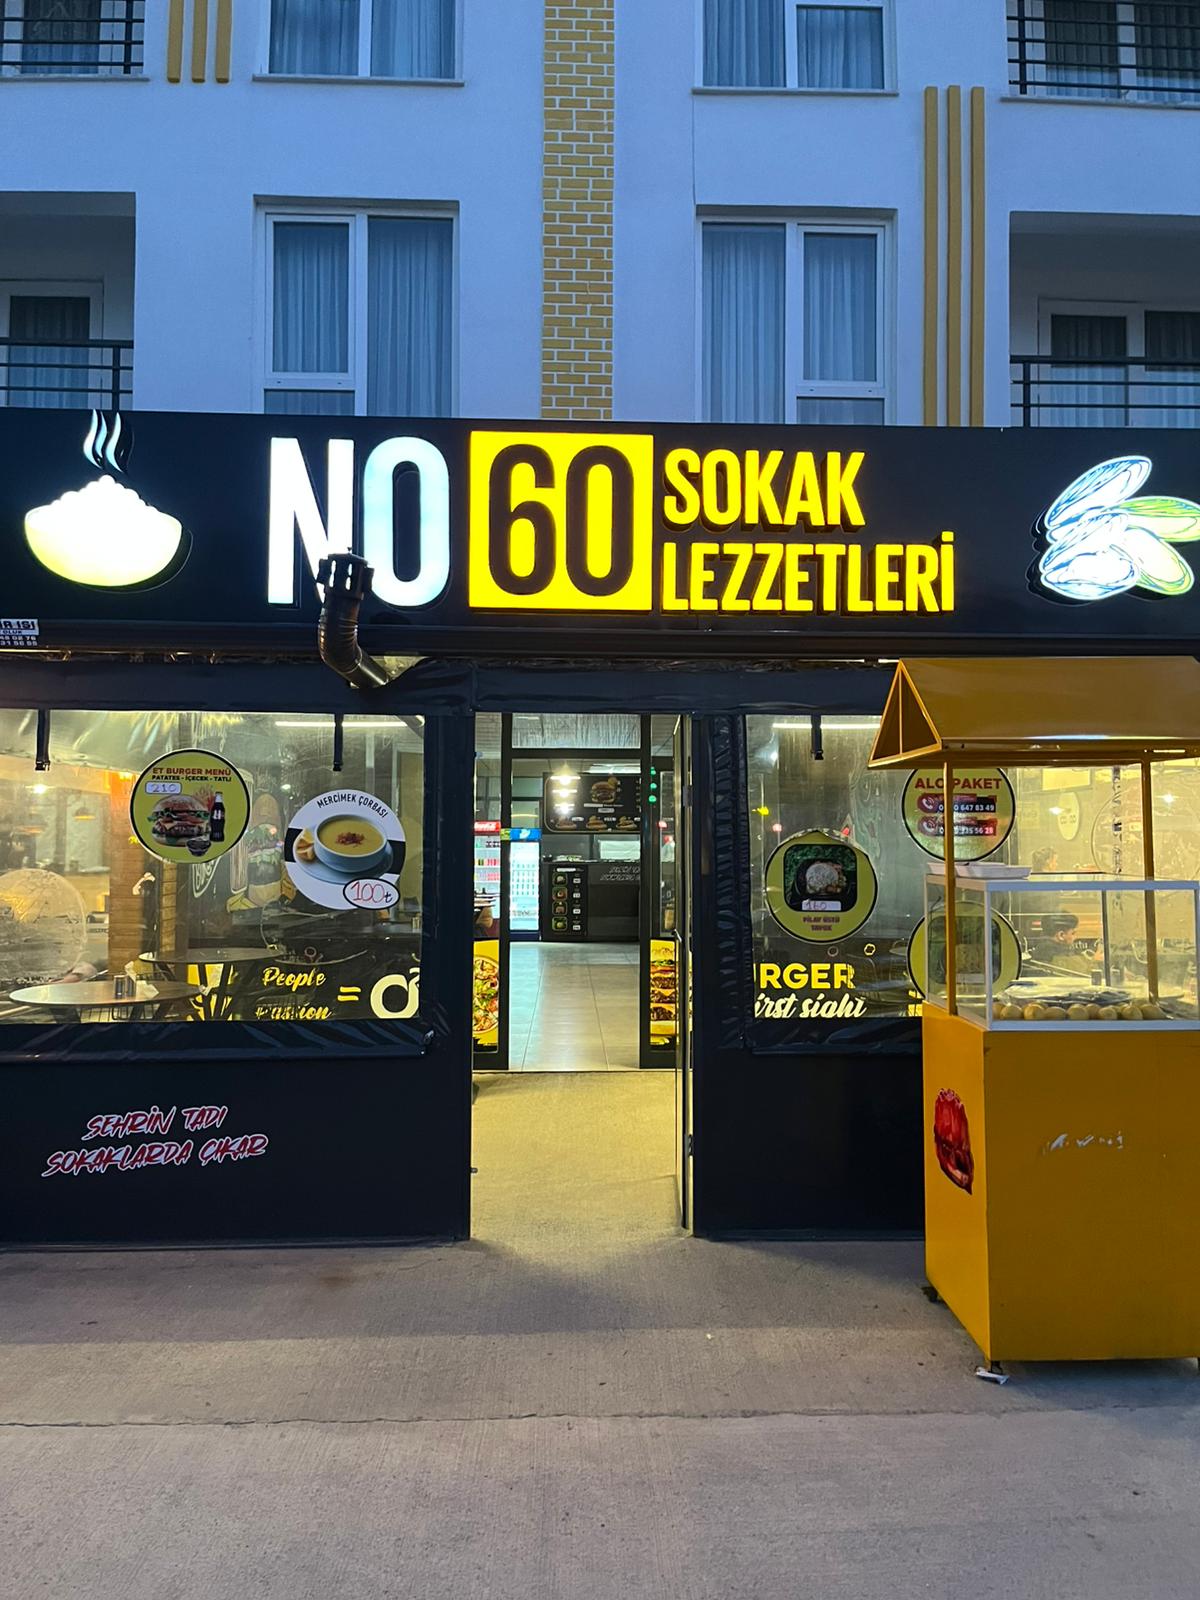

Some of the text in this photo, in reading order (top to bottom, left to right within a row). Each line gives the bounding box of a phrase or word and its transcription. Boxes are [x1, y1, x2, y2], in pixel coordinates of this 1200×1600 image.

[663, 447, 866, 527] SOKAK
[268, 436, 634, 606] NO 60
[662, 531, 955, 613] LEZZETLERİ
[953, 778, 1002, 789] PAKET
[316, 792, 357, 808] MERCİMEK
[262, 966, 326, 992] People
[753, 963, 856, 989] RGER
[182, 1105, 228, 1132] TADI
[41, 1133, 269, 1177] SOKAKLARDA ÇIKAR
